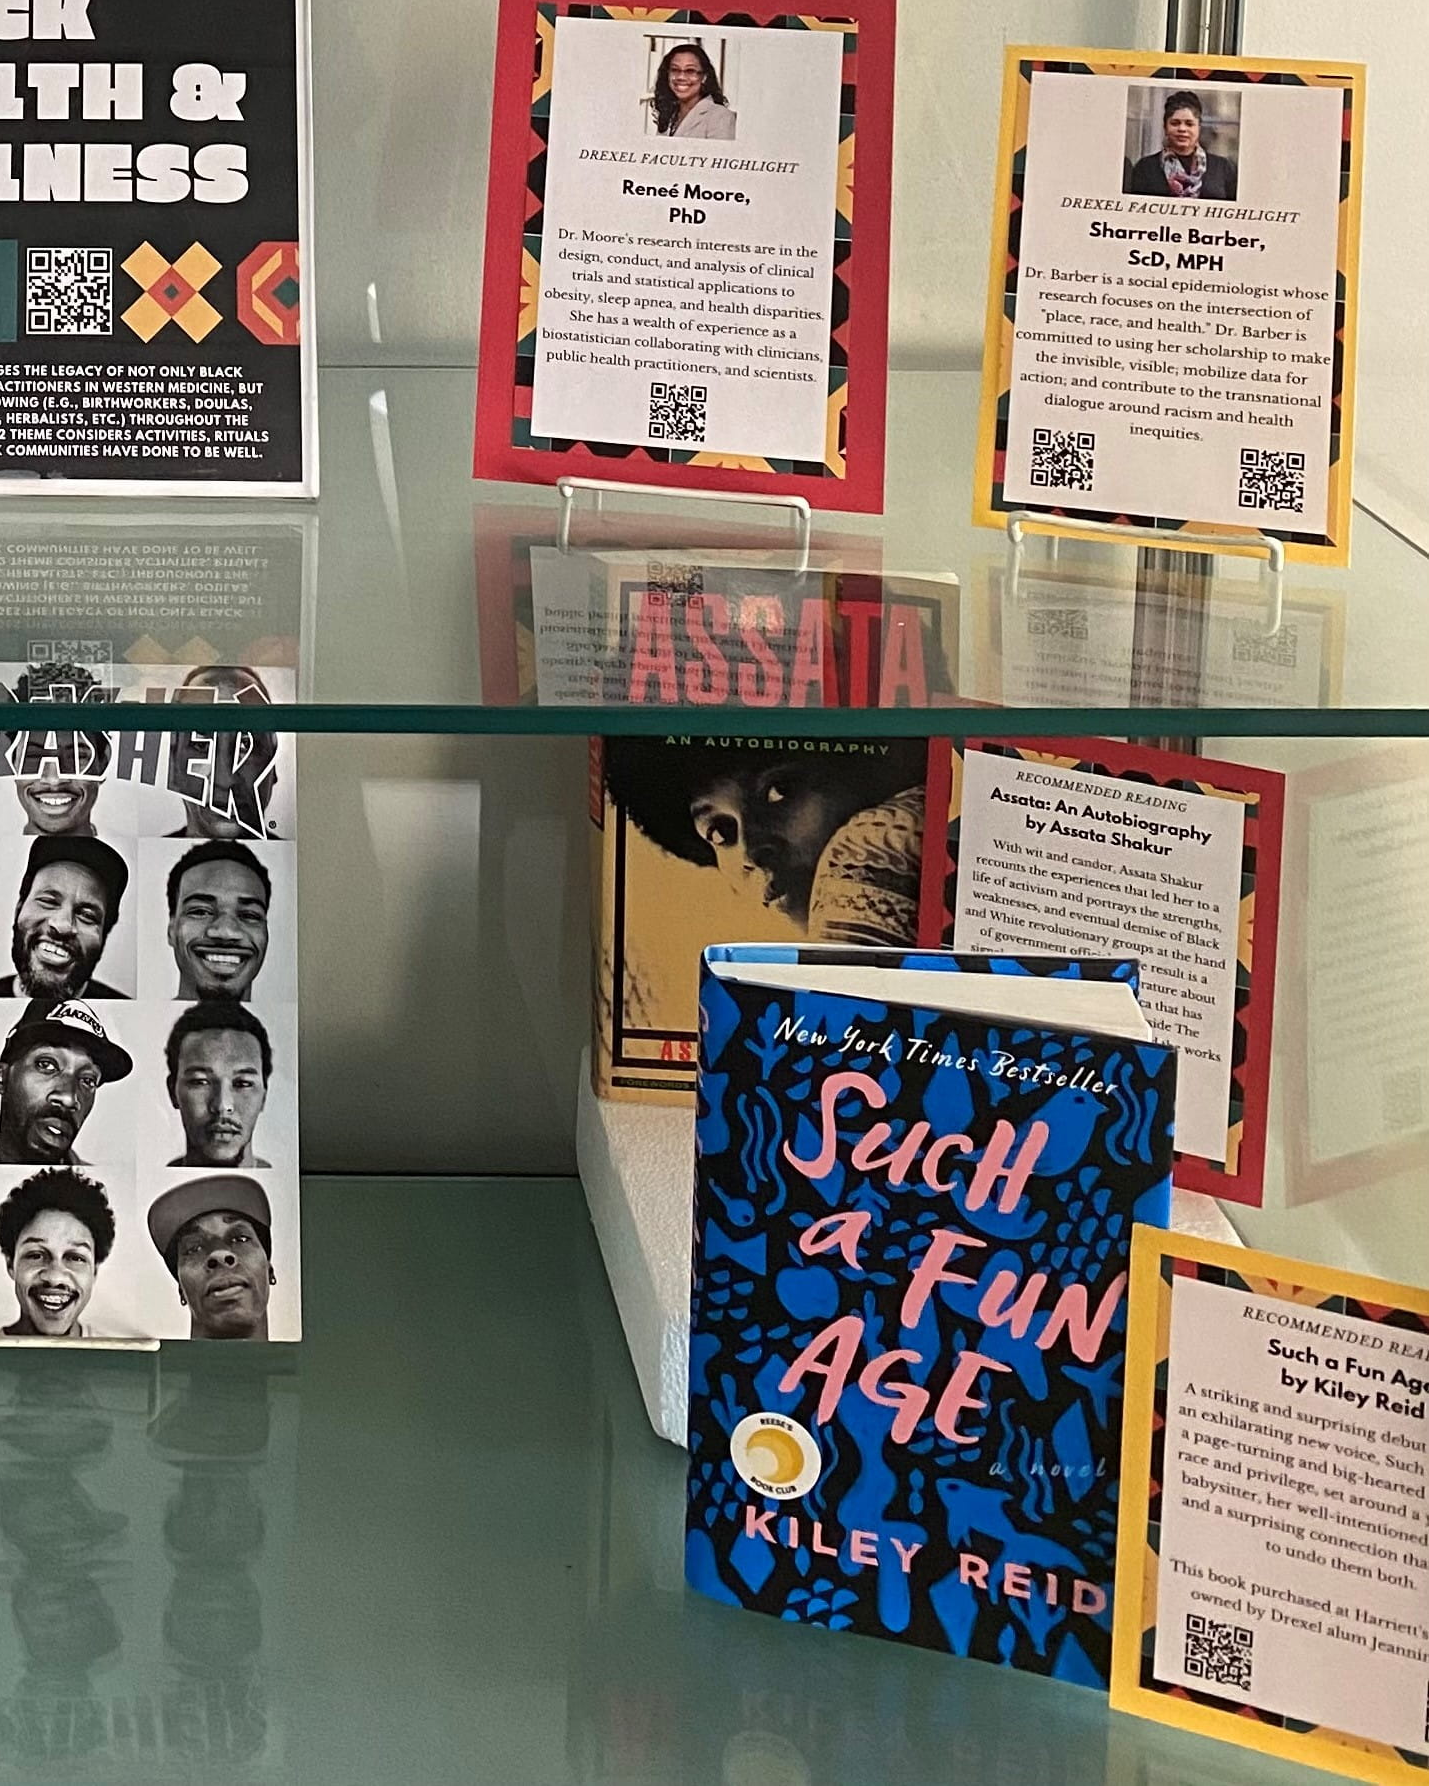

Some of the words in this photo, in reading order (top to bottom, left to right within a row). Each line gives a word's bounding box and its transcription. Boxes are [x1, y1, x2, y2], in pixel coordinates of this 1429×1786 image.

[169, 62, 247, 122] &
[622, 178, 680, 198] Reneé
[682, 182, 750, 206] Moore,
[1060, 196, 1124, 212] DREXEL
[1127, 200, 1201, 217] FACULTY
[1202, 205, 1300, 223] HIGHLIGHT
[668, 206, 706, 225] PhD
[1088, 220, 1182, 243] Sharrelle
[1187, 227, 1265, 252] Barber,
[1126, 248, 1171, 271] ScD,
[1175, 252, 1223, 272] MPH
[5, 443, 99, 456] COMMUNITIES
[102, 444, 138, 457] HAVE
[141, 444, 179, 457] DONE
[182, 445, 201, 458] TO
[204, 445, 220, 458] BE
[223, 445, 263, 458] WELL.
[628, 591, 928, 708] ASSATA
[665, 735, 691, 746] AN
[705, 736, 890, 756] AUTOBIOGRAPHY
[989, 786, 1051, 811] Assata:
[1053, 798, 1078, 816] An
[1080, 804, 1212, 846] Autobiography
[1024, 813, 1047, 834] by
[1048, 818, 1106, 844] Assata
[1108, 830, 1173, 856] Shakur
[773, 1015, 827, 1046] New
[839, 1025, 894, 1062] York
[906, 1037, 980, 1072] Times
[988, 1050, 1120, 1096] Bestseller
[799, 1208, 872, 1270] a
[1242, 1305, 1383, 1349] RECOMMENDED
[1266, 1337, 1319, 1366] Such
[1324, 1357, 1340, 1372] a
[1345, 1356, 1386, 1382] Fun
[1280, 1366, 1309, 1394] by
[1313, 1375, 1371, 1409] Kiley
[1374, 1390, 1425, 1420] Reid
[750, 1476, 773, 1493] BOOK
[775, 1485, 797, 1496] CLUB
[989, 1461, 1005, 1476] a
[1030, 1456, 1106, 1478] novel
[744, 1506, 924, 1576] KILEY
[958, 1552, 1108, 1617] REID
